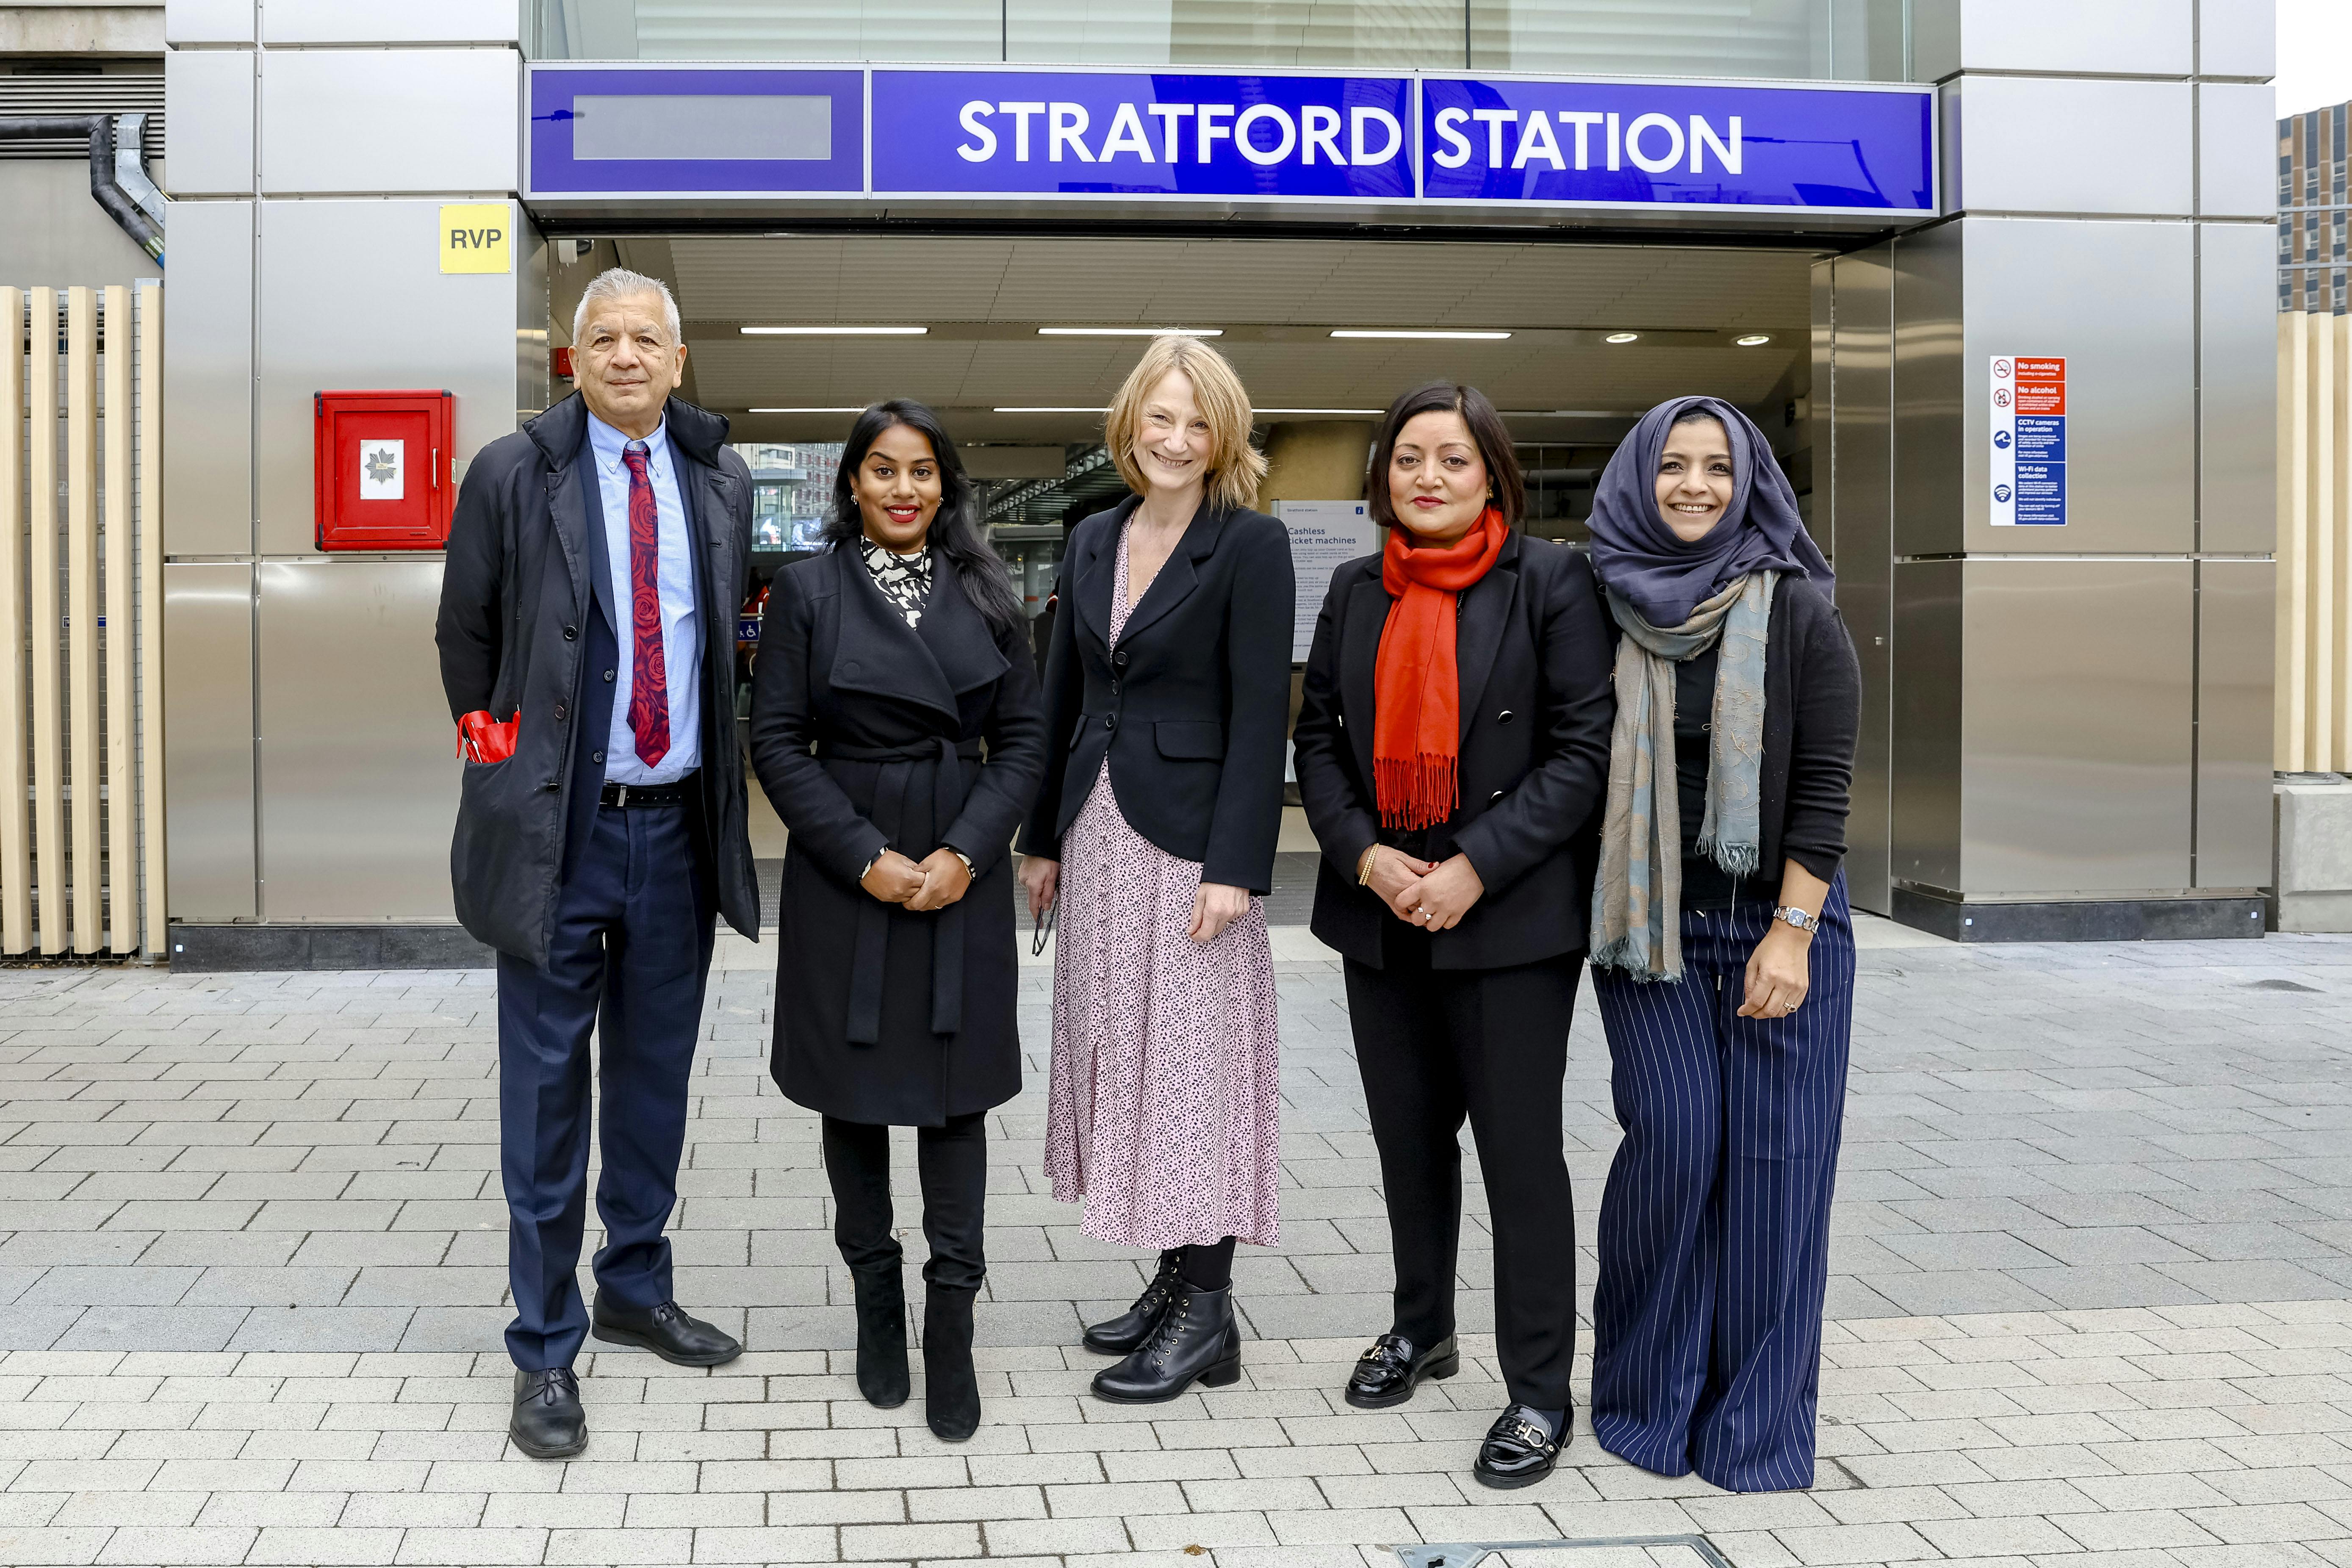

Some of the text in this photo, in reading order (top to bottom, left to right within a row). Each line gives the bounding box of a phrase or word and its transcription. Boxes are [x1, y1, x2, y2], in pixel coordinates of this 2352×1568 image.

[956, 100, 1742, 175] STRATFORD STATION
[452, 229, 501, 249] RVP
[2030, 362, 2060, 371] smoking
